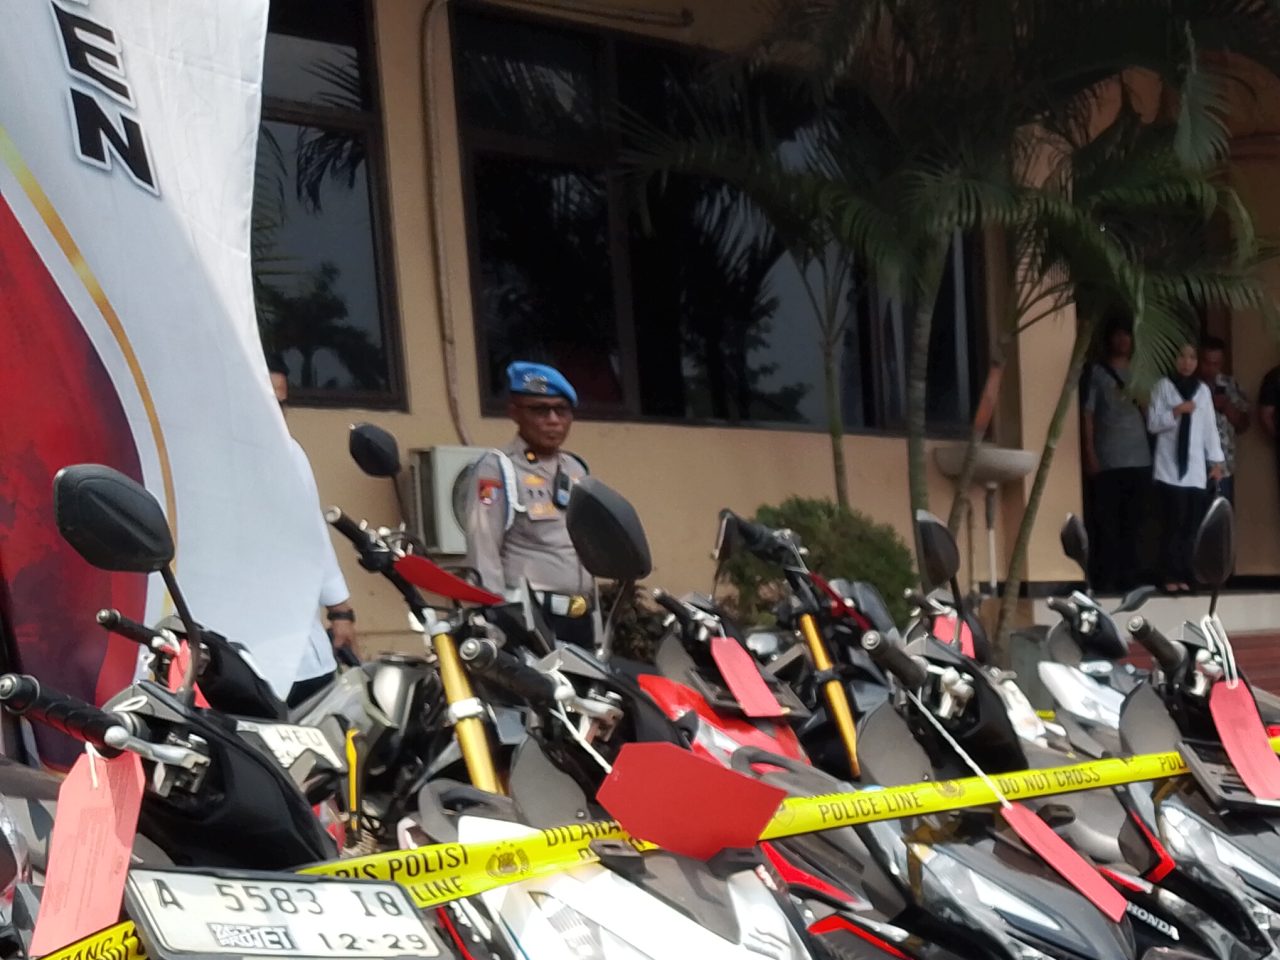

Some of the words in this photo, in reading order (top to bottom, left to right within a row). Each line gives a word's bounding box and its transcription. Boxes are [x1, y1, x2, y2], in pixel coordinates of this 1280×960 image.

[1000, 776, 1019, 796] DO
[1023, 771, 1050, 792] NOT
[1056, 765, 1101, 788] CROSS
[819, 796, 882, 824] POLICE
[887, 790, 923, 813] LINE
[543, 820, 621, 847] DILARA
[387, 844, 469, 881] POLISI
[152, 879, 184, 910] A
[214, 883, 324, 915] 5583
[410, 875, 463, 902] LINE
[1126, 900, 1180, 941] HONDA
